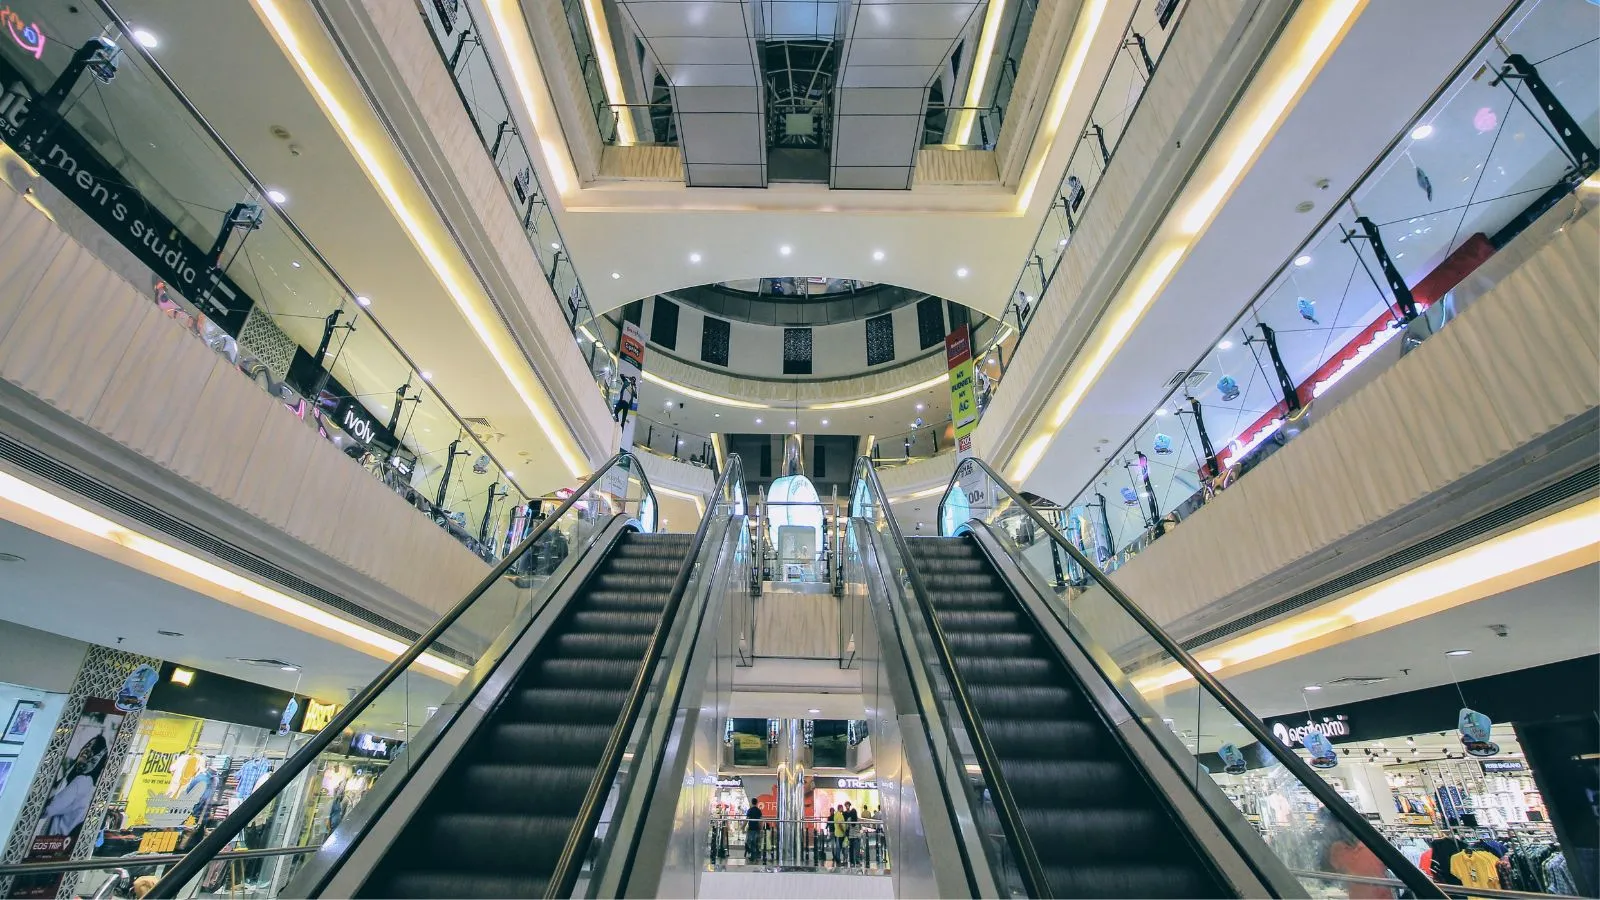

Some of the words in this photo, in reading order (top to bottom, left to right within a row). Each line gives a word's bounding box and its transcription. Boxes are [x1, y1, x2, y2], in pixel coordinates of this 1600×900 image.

[48, 143, 129, 222] men's
[130, 218, 197, 284] studio
[958, 400, 969, 413] AC
[344, 405, 376, 444] ivolv
[49, 842, 62, 850] TRIP
